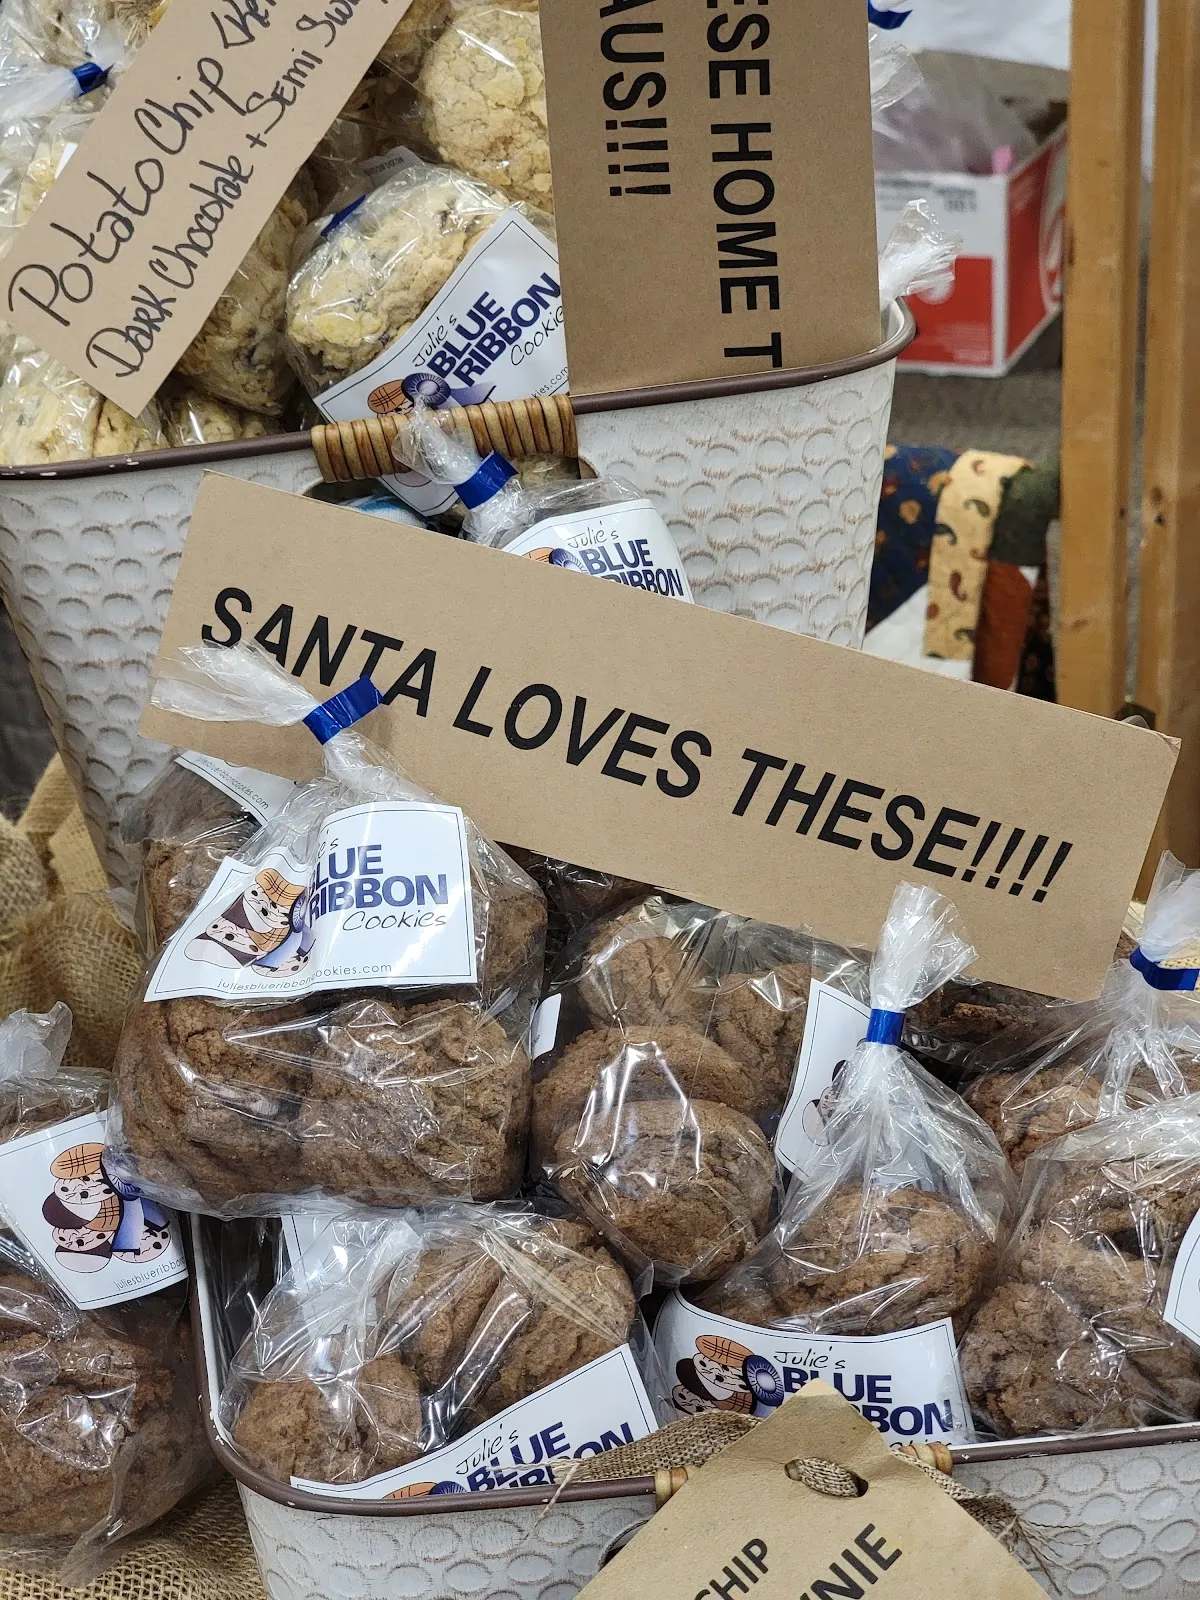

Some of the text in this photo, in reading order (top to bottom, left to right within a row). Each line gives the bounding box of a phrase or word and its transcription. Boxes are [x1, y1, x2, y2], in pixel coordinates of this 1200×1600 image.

[706, 0, 771, 99] SE
[8, 158, 164, 327] Potato
[135, 56, 248, 155] Chip
[711, 122, 780, 313] HOME
[412, 313, 457, 367] Julie's
[426, 291, 505, 379] BLUE
[452, 272, 561, 387] RIBBON
[567, 520, 619, 548] Julie's
[579, 538, 654, 575] BLUE
[201, 586, 1074, 903] SANTA LOVES THESE!!!!
[309, 873, 449, 929] RIBBON
[342, 909, 447, 931] Cookies
[773, 1345, 846, 1370] Julie's
[782, 1366, 893, 1404] BUE
[456, 1424, 519, 1475] Julie's
[467, 1421, 571, 1493] BLUE
